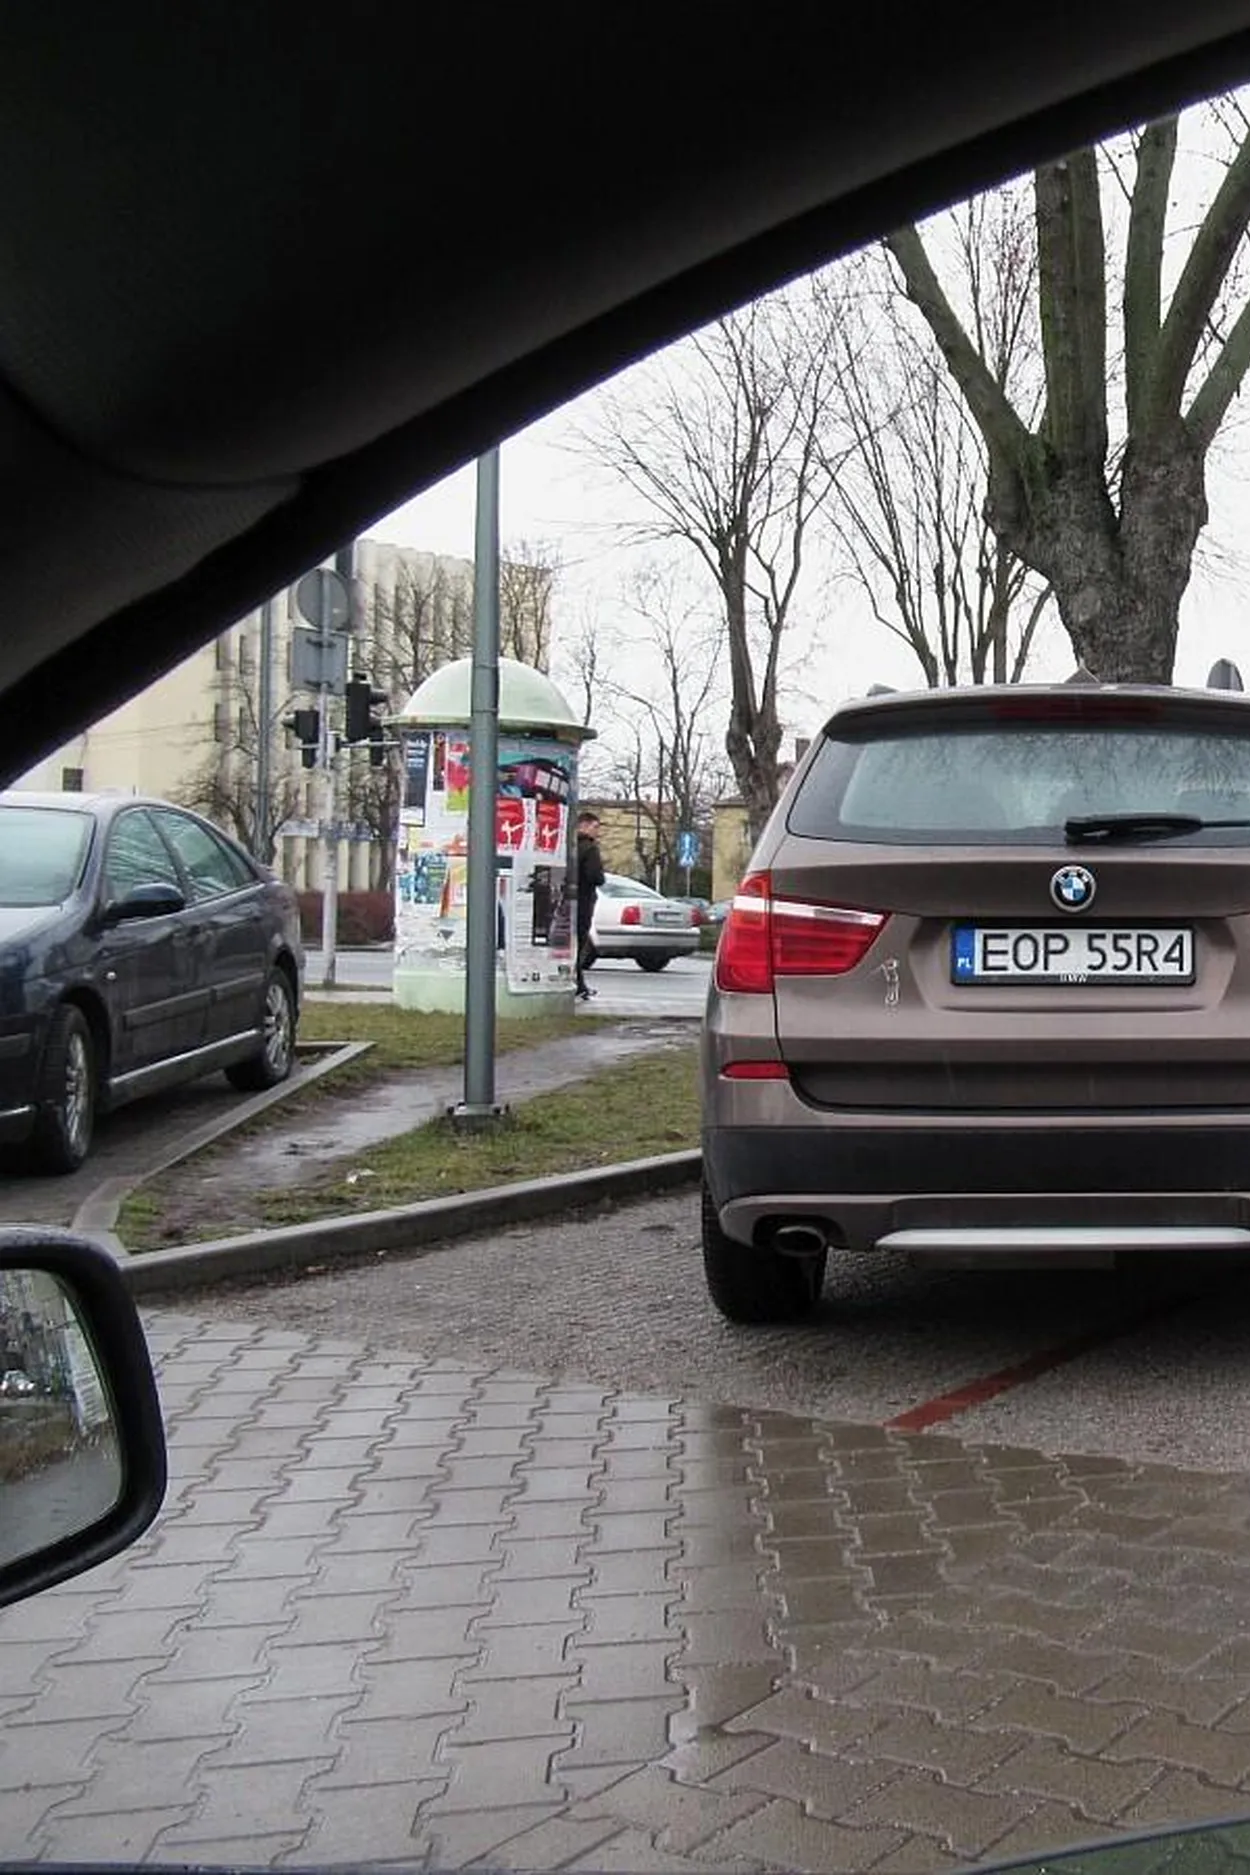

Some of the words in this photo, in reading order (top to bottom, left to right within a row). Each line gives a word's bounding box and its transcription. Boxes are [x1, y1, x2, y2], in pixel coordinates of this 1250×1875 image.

[957, 958, 972, 968] PL
[981, 932, 1070, 972] EOP
[1086, 932, 1186, 972] 55R4
